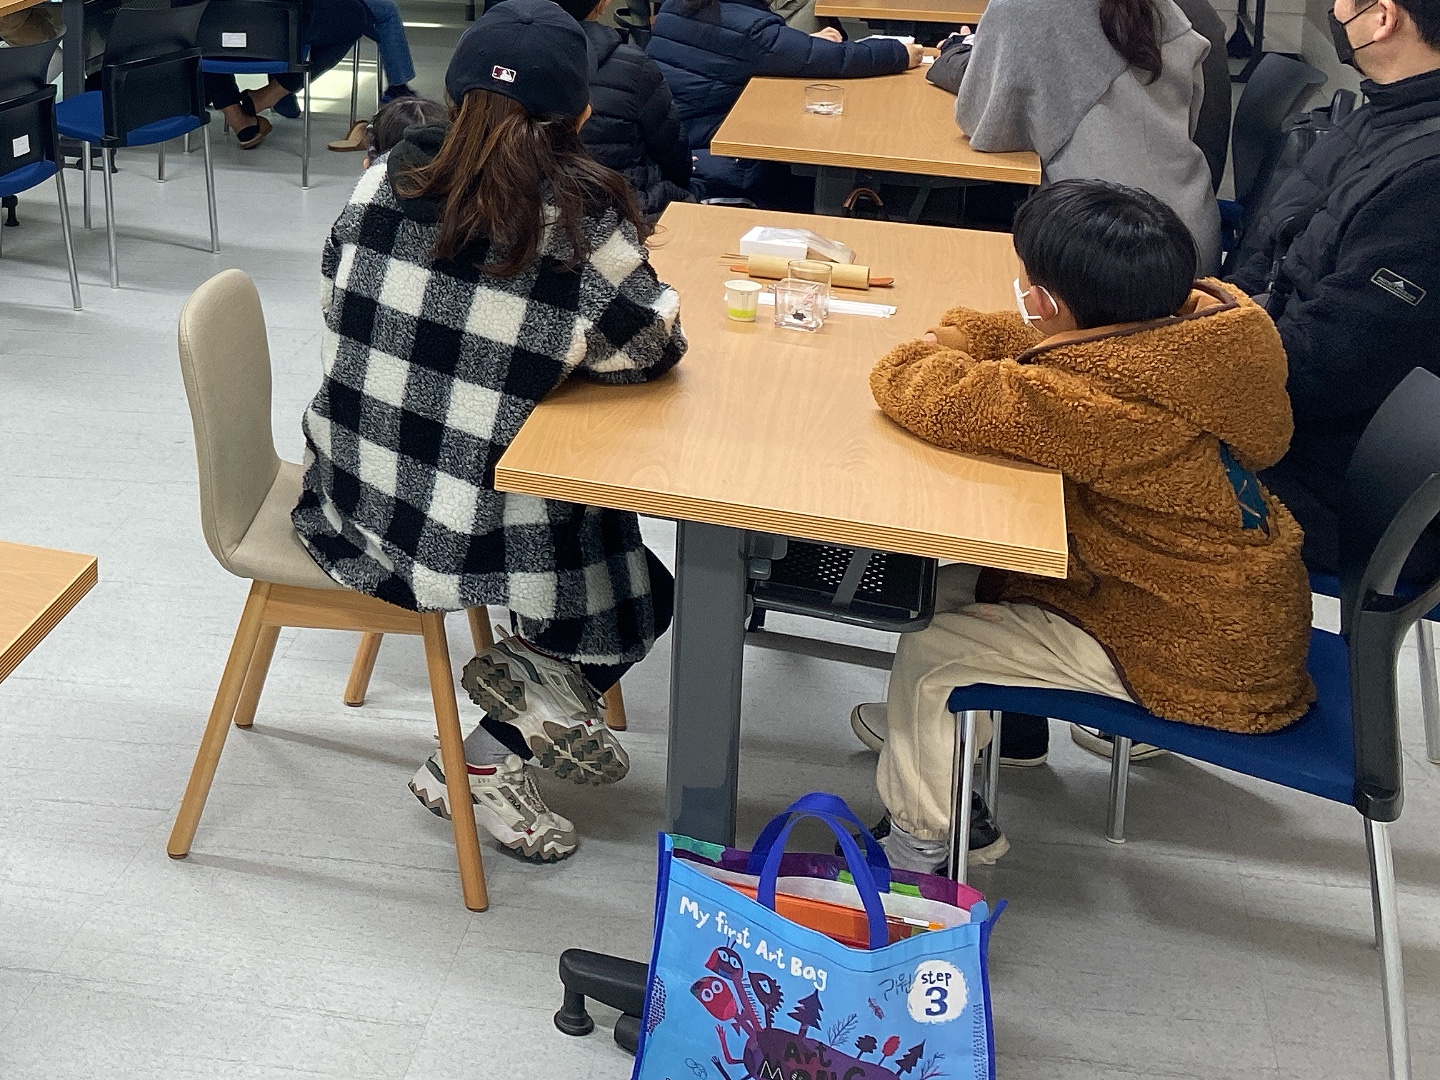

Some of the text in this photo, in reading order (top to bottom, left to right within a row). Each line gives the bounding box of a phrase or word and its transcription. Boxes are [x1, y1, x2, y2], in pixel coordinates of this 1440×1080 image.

[679, 896, 828, 992] My first Art Bag
[920, 971, 952, 987] step
[924, 986, 948, 1017] 3
[784, 1040, 832, 1069] Art
